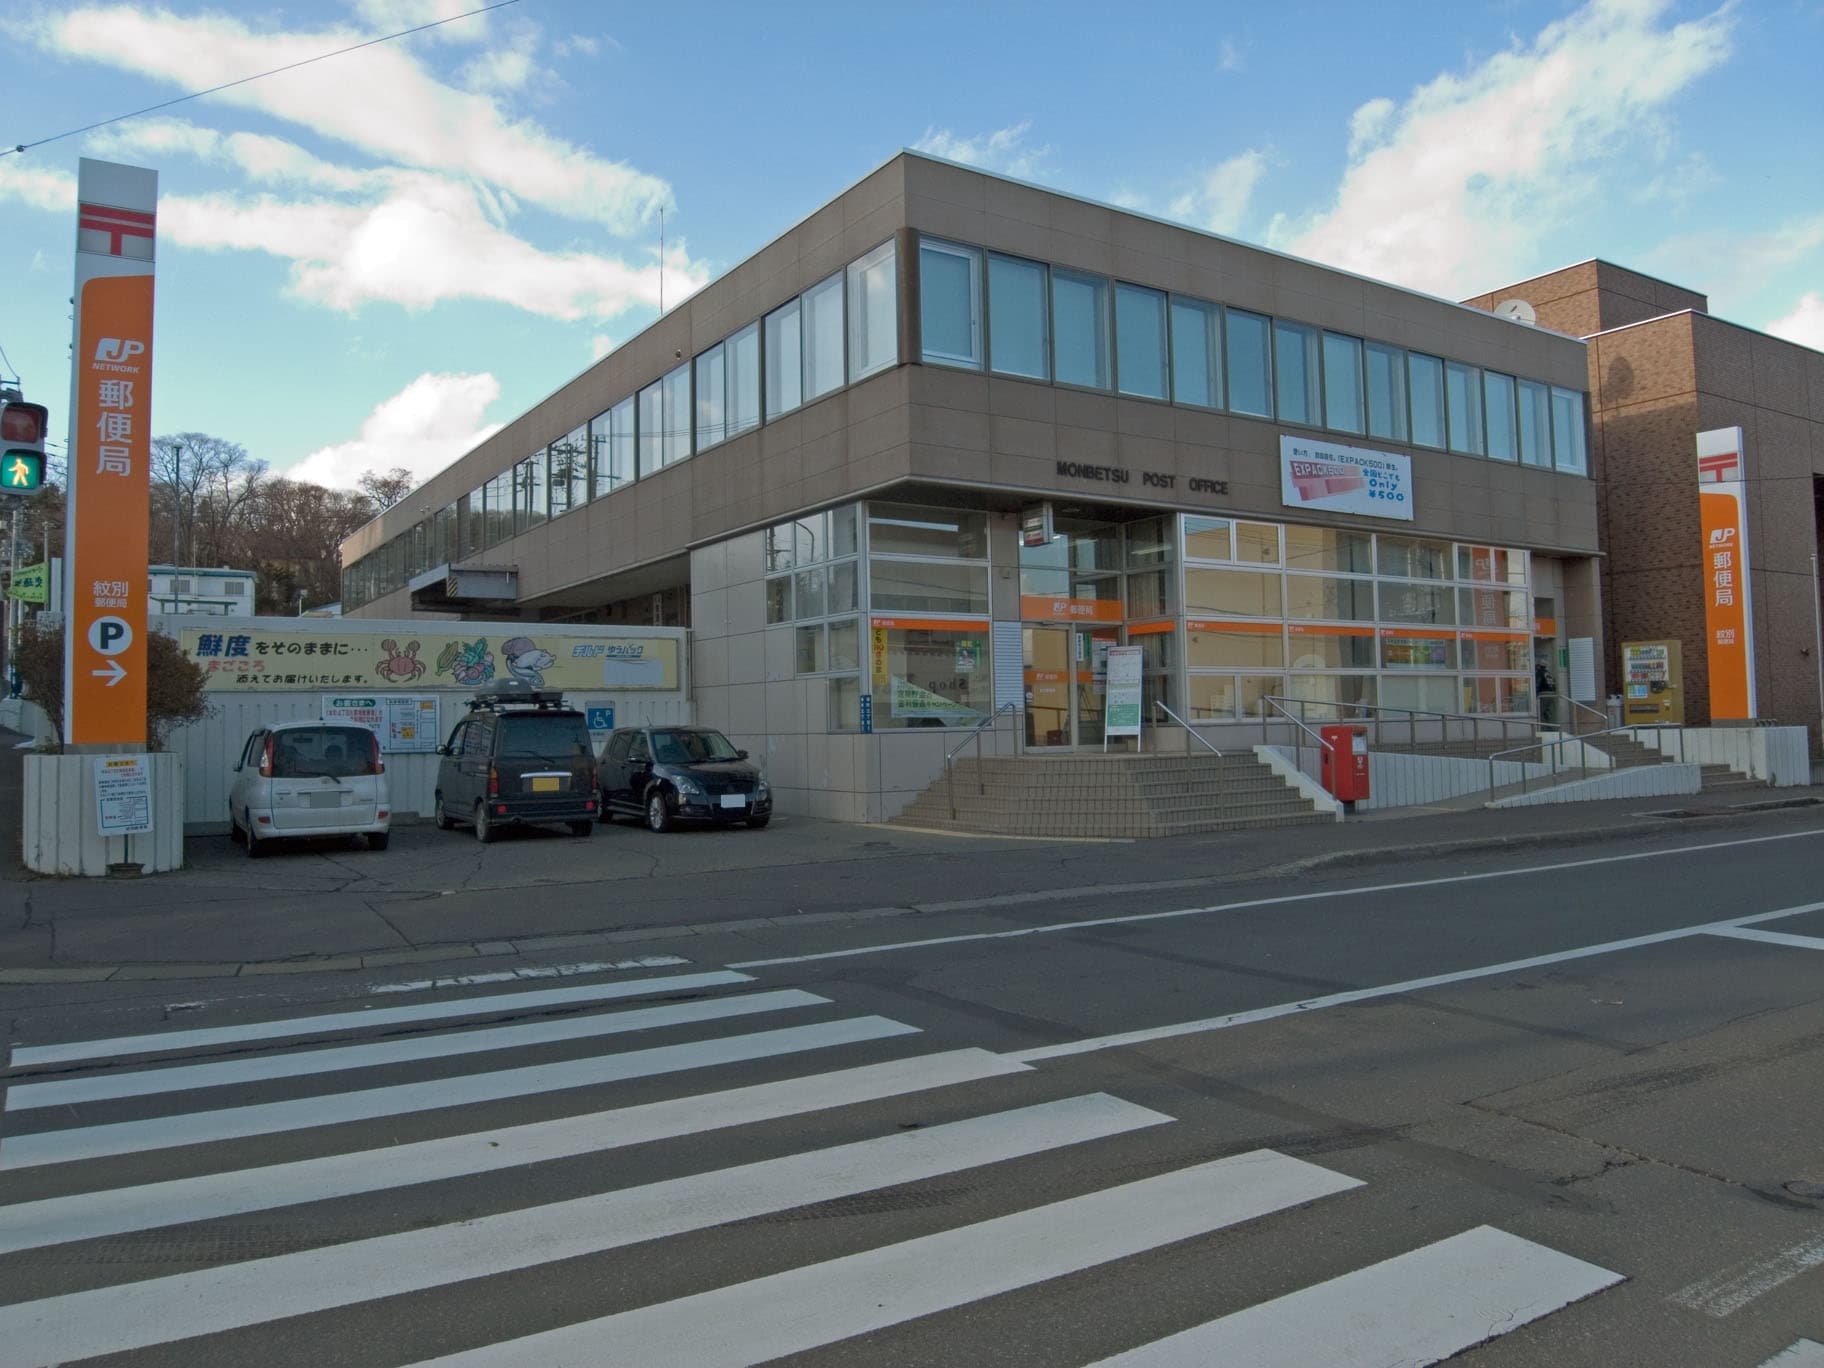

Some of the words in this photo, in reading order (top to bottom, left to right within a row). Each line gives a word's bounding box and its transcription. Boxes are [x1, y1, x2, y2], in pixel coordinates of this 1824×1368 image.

[95, 338, 145, 362] JP
[92, 362, 141, 374] NETWORK
[96, 379, 134, 477] 郵便局
[1056, 460, 1130, 484] MONBETSU
[1142, 472, 1177, 489] POST
[1189, 477, 1229, 496] OFFICE
[1369, 478, 1398, 491] Only
[1368, 489, 1405, 502] ¥500
[1713, 551, 1733, 607] 郵便局
[93, 580, 129, 597] 紋別
[100, 622, 125, 650] P
[207, 660, 266, 673] まごころ
[236, 673, 369, 685] 添えてお届けいたします。
